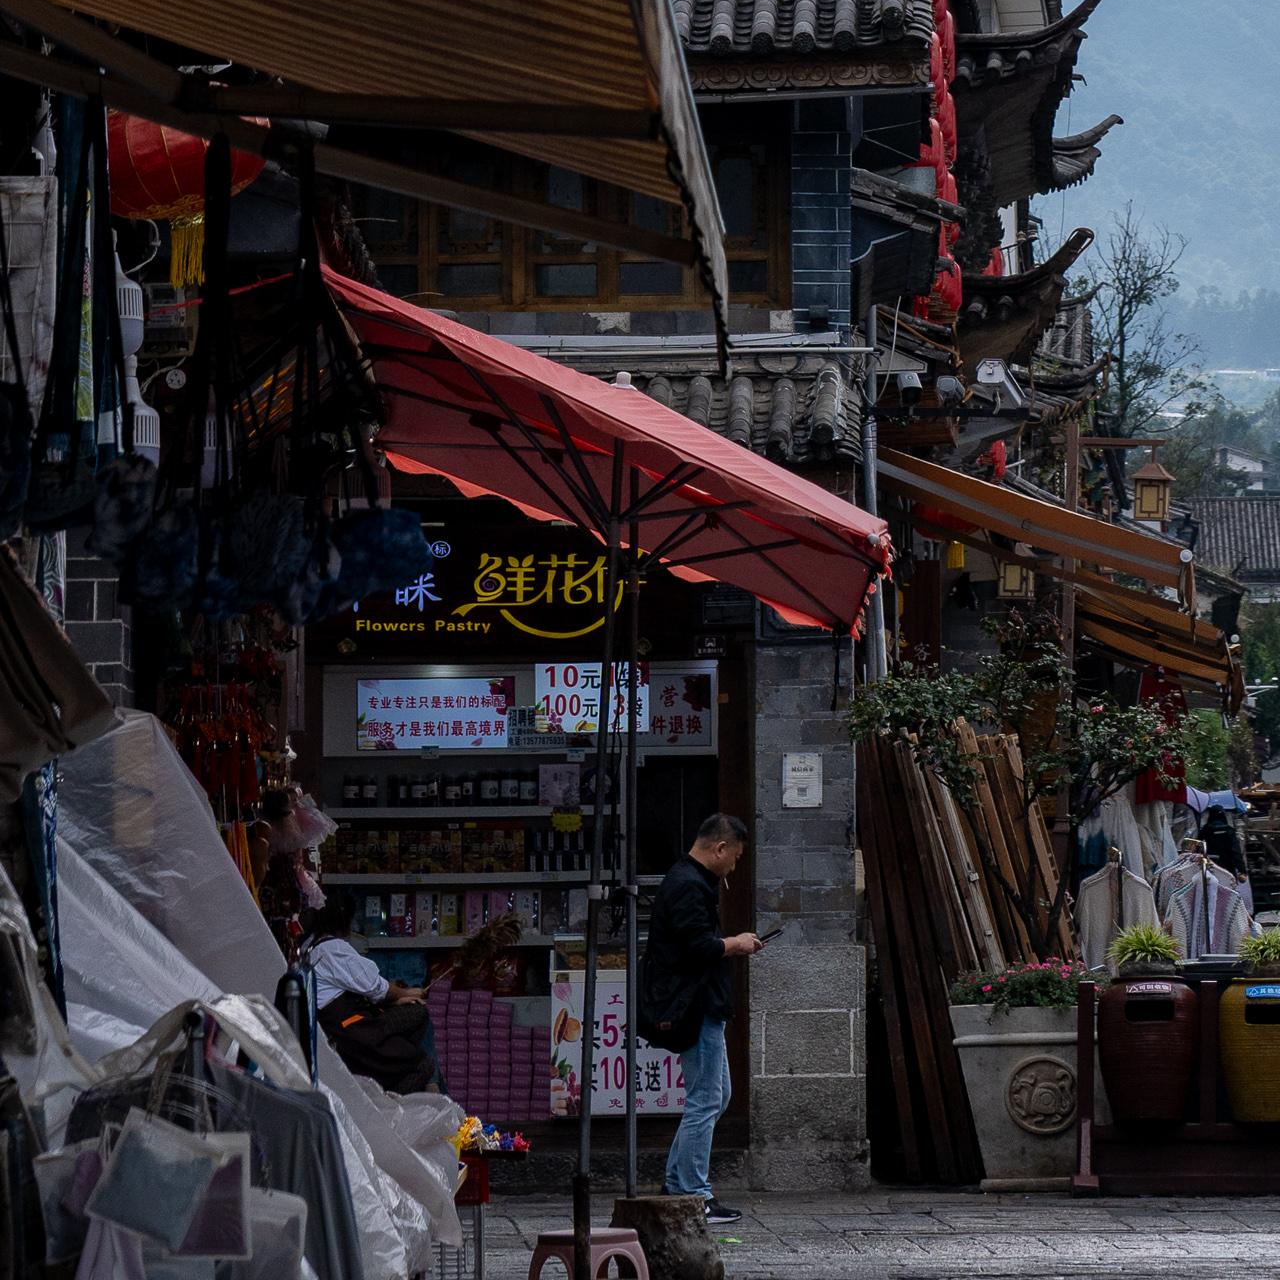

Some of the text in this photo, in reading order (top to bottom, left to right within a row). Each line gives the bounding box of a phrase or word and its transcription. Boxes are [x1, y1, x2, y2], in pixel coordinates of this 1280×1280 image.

[434, 619, 491, 634] Pastry
[545, 665, 600, 689] 10元
[367, 695, 505, 709] 专业专注只是我们的标配
[542, 693, 599, 718] 100元
[367, 720, 505, 737] 服务才是我们最高境界
